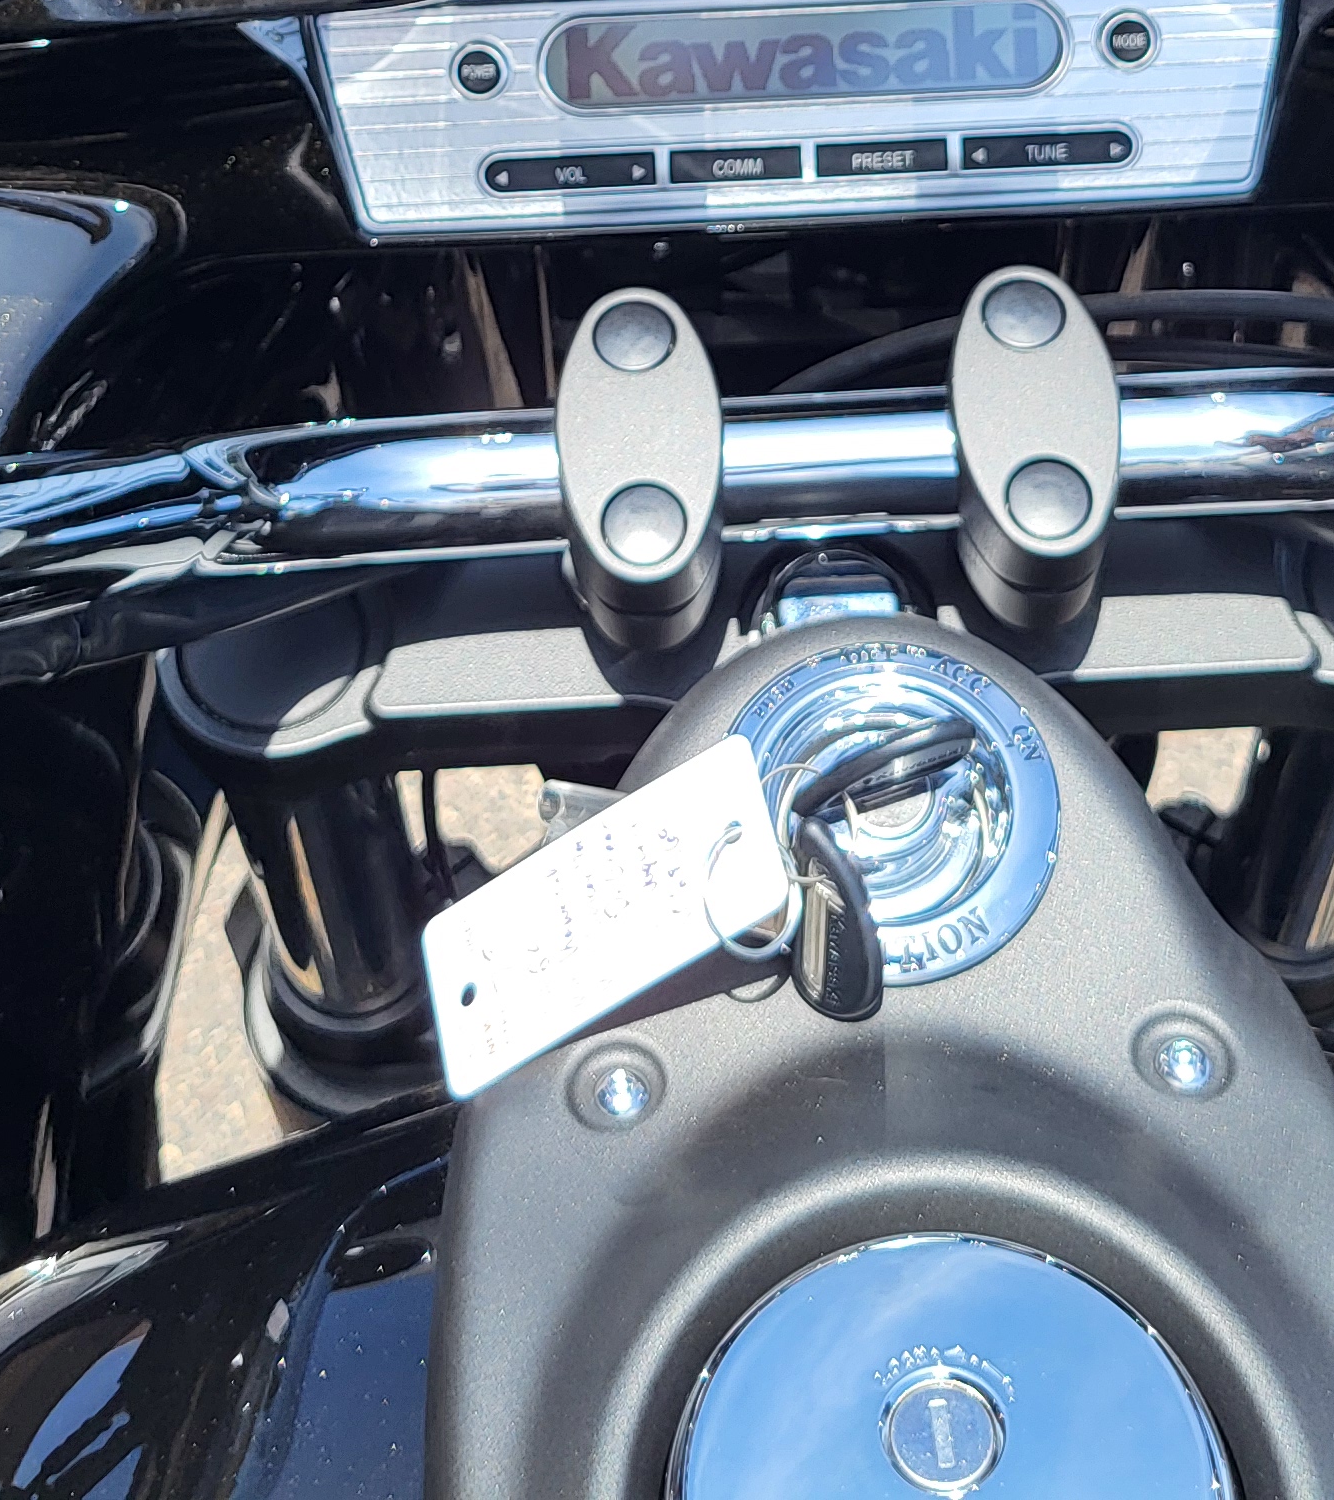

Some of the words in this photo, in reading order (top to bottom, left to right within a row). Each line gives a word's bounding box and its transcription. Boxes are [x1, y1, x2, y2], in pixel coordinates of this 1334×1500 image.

[1112, 30, 1148, 49] MODE
[566, 3, 1038, 98] Kawasaki
[461, 62, 497, 82] POWER
[852, 150, 915, 172] PRESET
[1025, 142, 1069, 163] TUNE
[555, 165, 588, 185] VOL
[712, 157, 766, 178] COMM
[930, 656, 991, 697] ACC
[1012, 725, 1044, 761] ON
